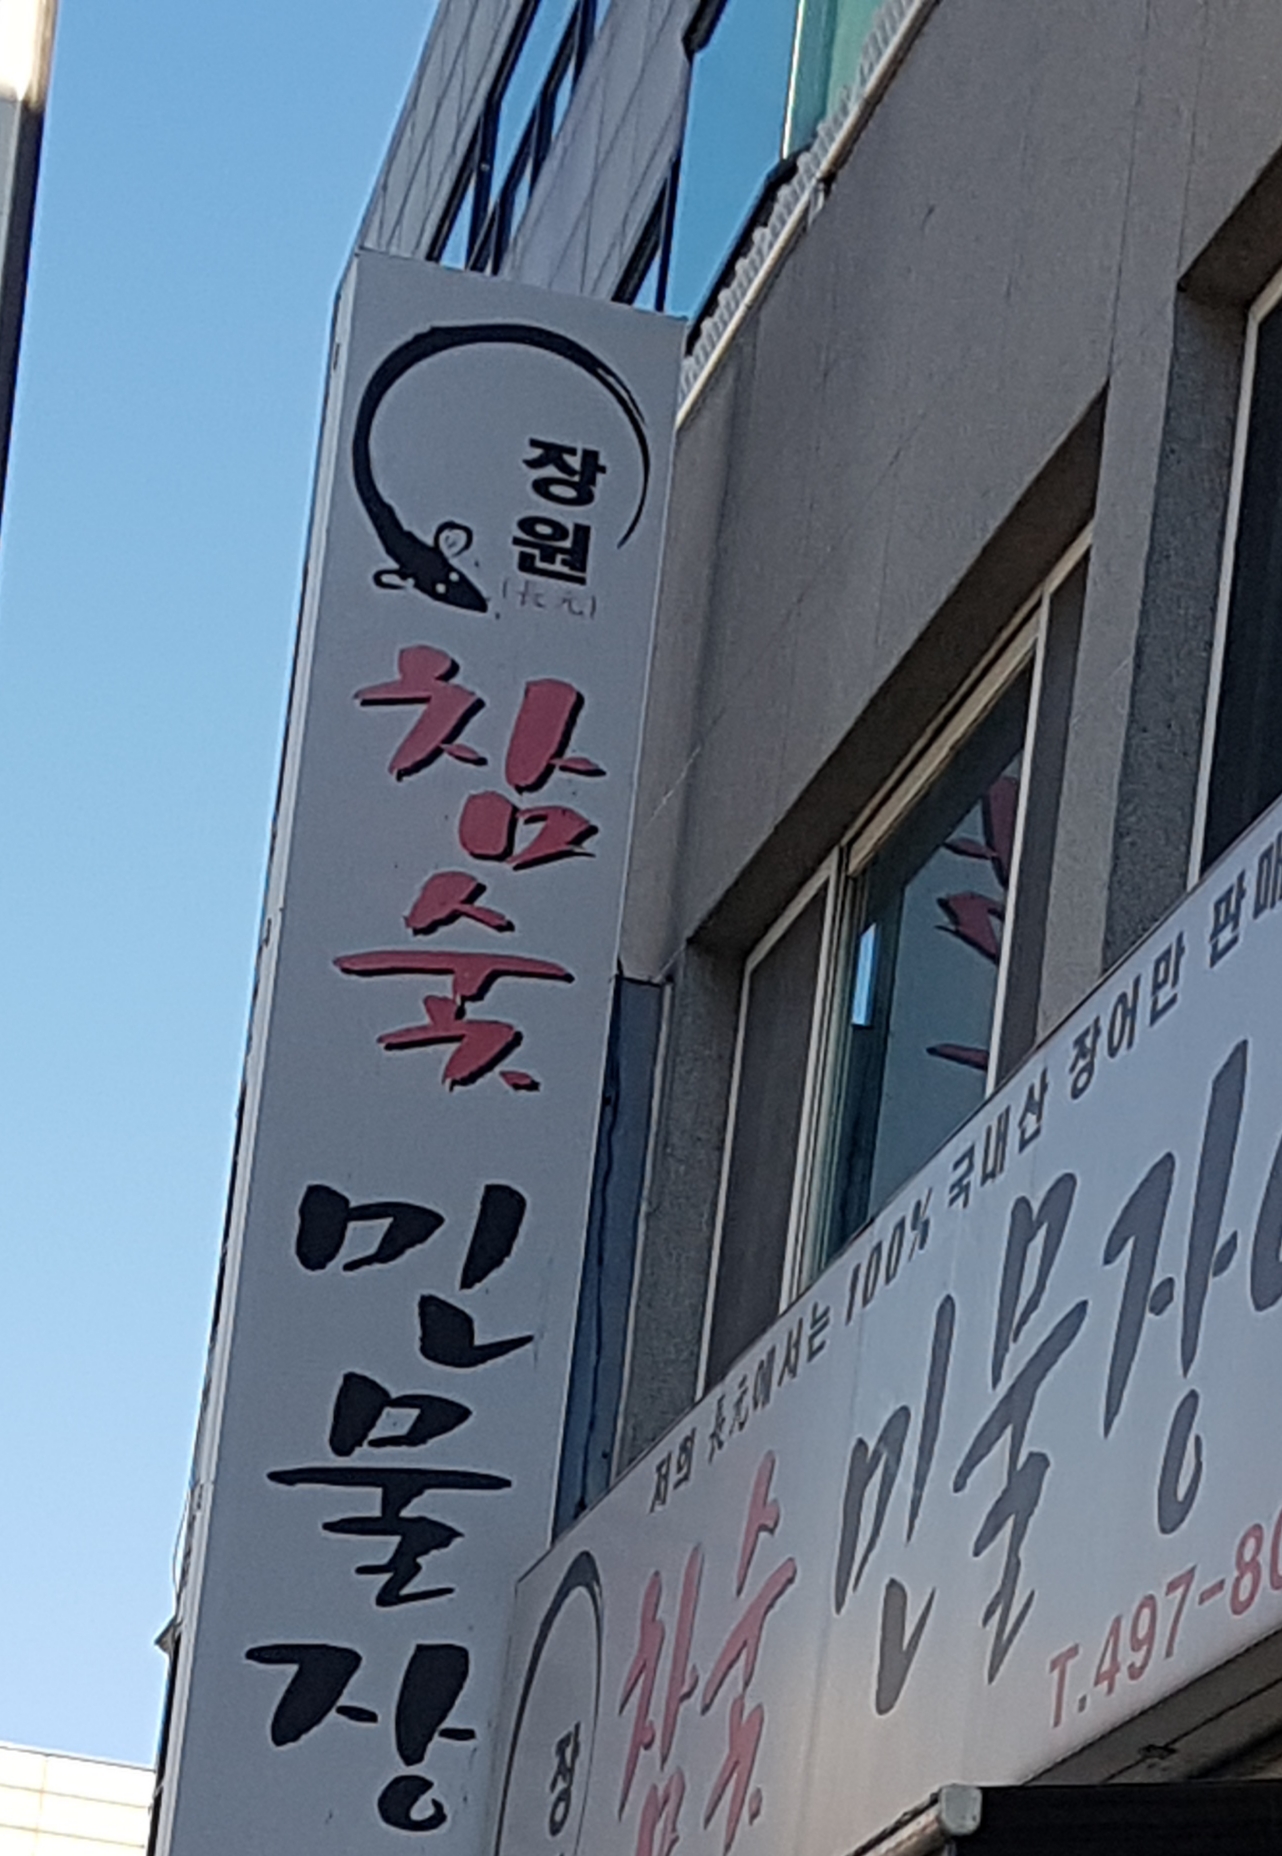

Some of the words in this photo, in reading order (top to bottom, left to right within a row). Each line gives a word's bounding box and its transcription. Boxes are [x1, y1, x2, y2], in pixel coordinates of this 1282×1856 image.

[511, 436, 607, 588] 장원
[650, 1428, 697, 1514] 저의
[845, 1187, 932, 1327] 100%
[949, 1067, 1049, 1209] 국내산
[1069, 931, 1186, 1101] 장어만
